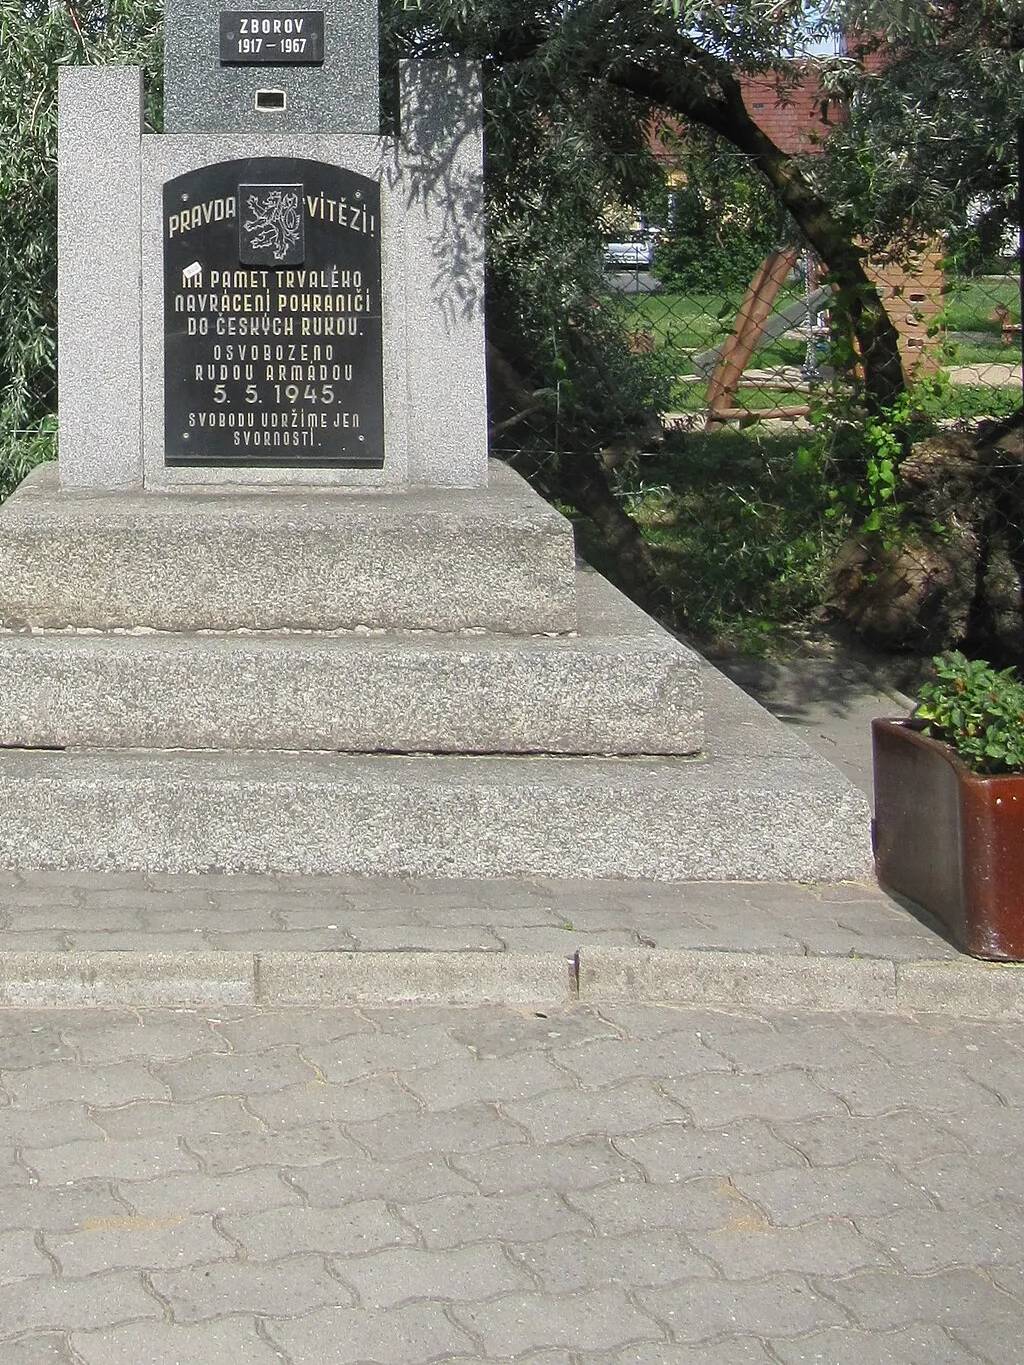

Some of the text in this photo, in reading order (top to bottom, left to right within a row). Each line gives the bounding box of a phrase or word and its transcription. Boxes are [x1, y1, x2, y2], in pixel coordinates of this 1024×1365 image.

[239, 18, 304, 34] ZBOROV
[237, 38, 263, 54] 1917
[279, 38, 307, 54] 1967
[169, 190, 375, 238] PRAVDA VÍTĚZÍ!
[275, 264, 362, 288] TRVALÉHO
[175, 288, 371, 312] NAVRÁCENÍ POHRANIČÍ
[187, 312, 364, 336] DO ČESKÝCH RUKOU.
[213, 344, 334, 361] OSVOBOZENO
[195, 360, 353, 381] RUDOU ARMÁDOU
[213, 384, 342, 404] 5. 5. 1945.
[188, 408, 360, 428] SVOBODU UDRŽÍME JEN
[233, 428, 322, 447] SVORNOSTÍ.
